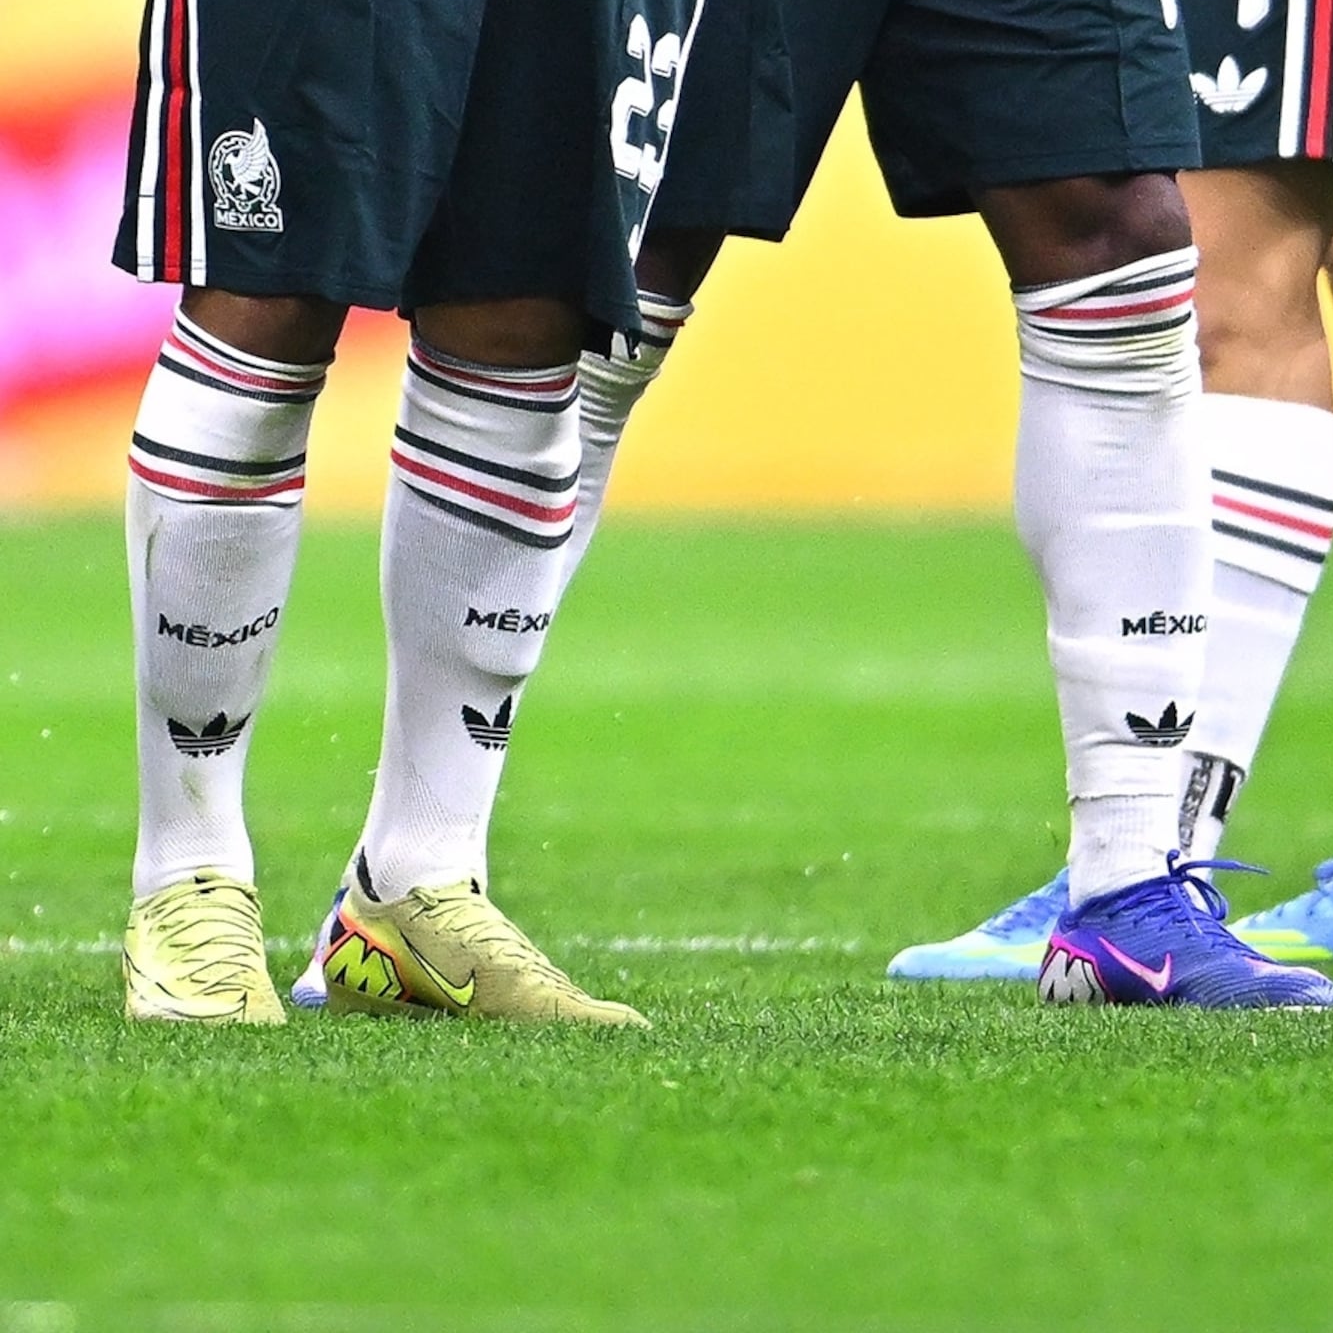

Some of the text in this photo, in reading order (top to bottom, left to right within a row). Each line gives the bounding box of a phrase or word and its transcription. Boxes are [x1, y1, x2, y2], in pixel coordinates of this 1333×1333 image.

[217, 208, 279, 228] MÉXICO
[158, 607, 279, 647] MÉXICO
[1122, 610, 1207, 637] MÉXIC
